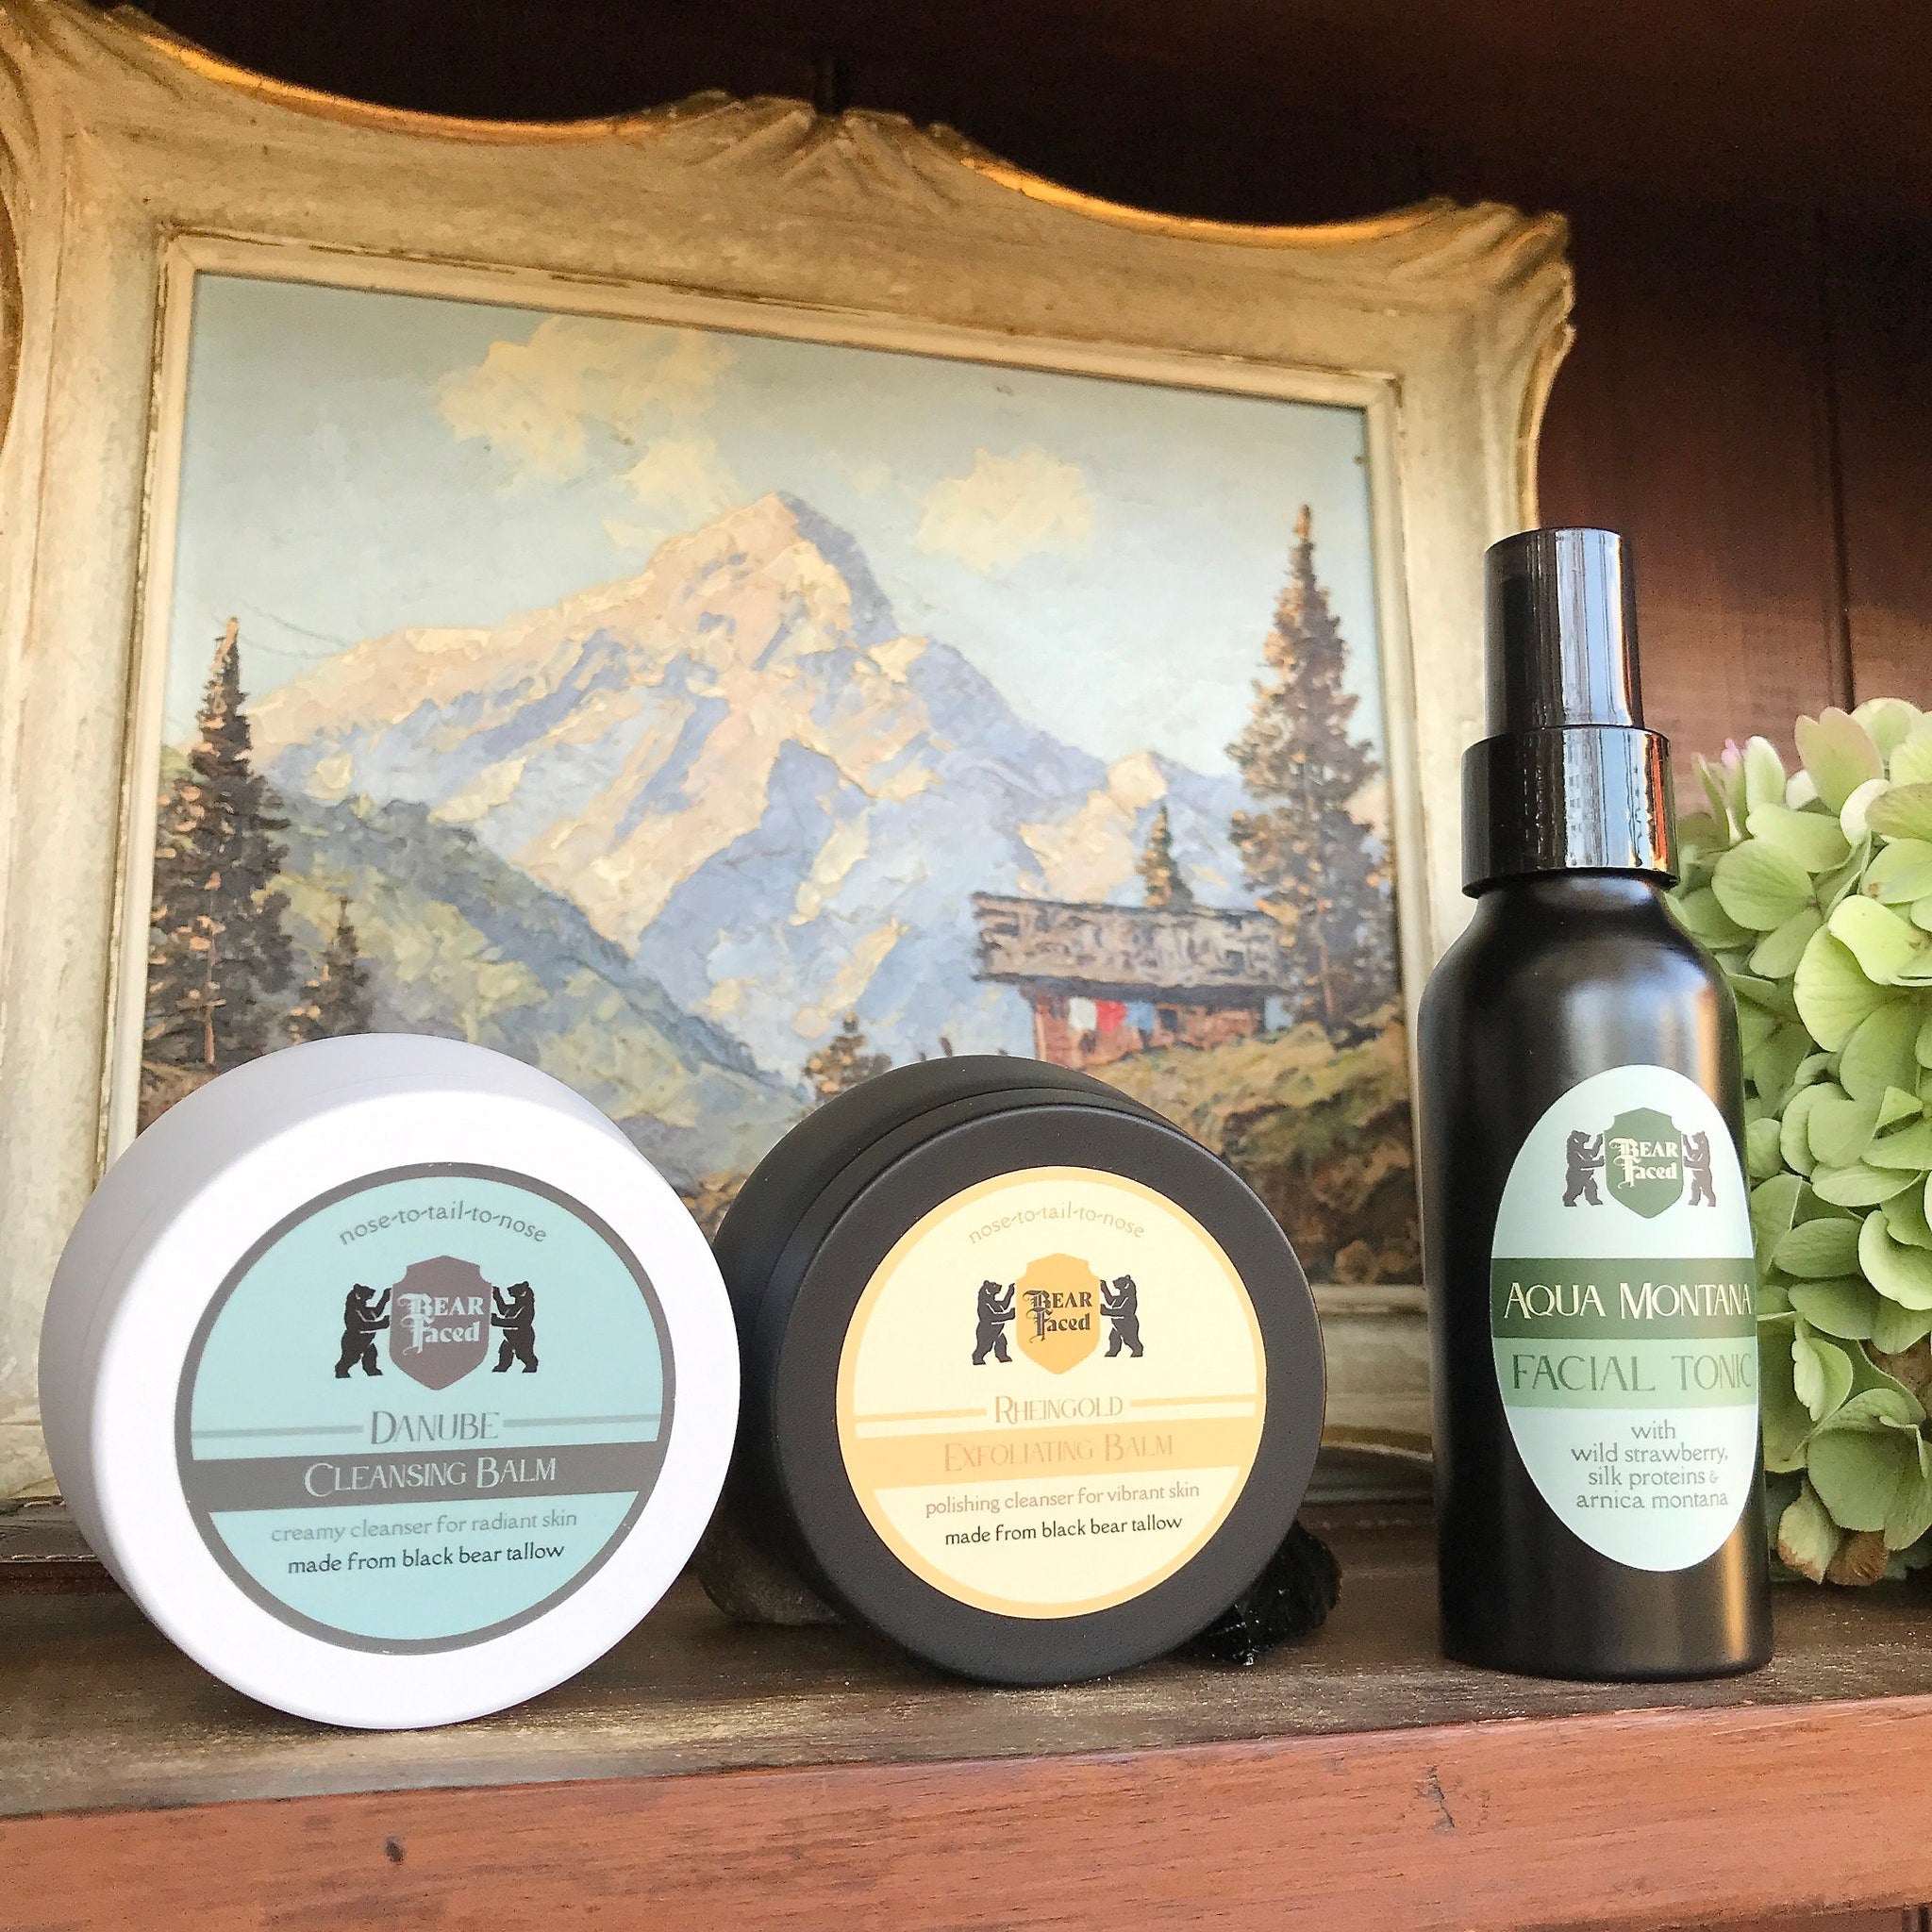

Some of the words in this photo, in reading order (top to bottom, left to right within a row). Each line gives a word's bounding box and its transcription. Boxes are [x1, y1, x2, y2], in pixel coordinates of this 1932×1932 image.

[340, 1200, 547, 1245] nose-to-tail-to-nose
[969, 1202, 1145, 1244] nose-to-tail-to-nose
[1504, 1282, 1606, 1319] AQUA
[1620, 1282, 1753, 1320] MONTANA
[1512, 1355, 1656, 1391] FACIAL
[1671, 1354, 1753, 1391] TONIC
[994, 1395, 1123, 1424] RHEINGOLD
[371, 1411, 500, 1445] DANUBE
[1631, 1420, 1675, 1440] with
[944, 1439, 1093, 1472] EXFOLIATING
[1105, 1433, 1174, 1461] BALM
[1571, 1444, 1620, 1462] wild
[1624, 1445, 1727, 1466] strawberry,
[305, 1460, 467, 1498] CLEANSING
[476, 1457, 557, 1489] BALM
[1588, 1467, 1623, 1486] silk
[1629, 1468, 1707, 1490] proteins
[925, 1494, 1000, 1518] polishing
[1005, 1490, 1074, 1509] cleanser
[1077, 1488, 1104, 1505] for
[1108, 1485, 1164, 1502] vibrant
[1169, 1483, 1200, 1499] skin
[1576, 1491, 1644, 1508] arnica
[1652, 1491, 1727, 1508] montana
[272, 1524, 343, 1543] creamy
[350, 1515, 433, 1539] cleanser
[436, 1515, 467, 1534] for
[472, 1511, 538, 1531] radiant
[542, 1511, 577, 1527] skin
[945, 1526, 991, 1545] made
[995, 1524, 1037, 1542] from
[1041, 1520, 1086, 1539] black
[1091, 1518, 1127, 1535] bear
[1131, 1515, 1183, 1532] tallow
[289, 1551, 341, 1574] made
[347, 1550, 396, 1571] from
[402, 1546, 453, 1568] black
[458, 1545, 502, 1564] bear
[507, 1541, 565, 1560] tallow
